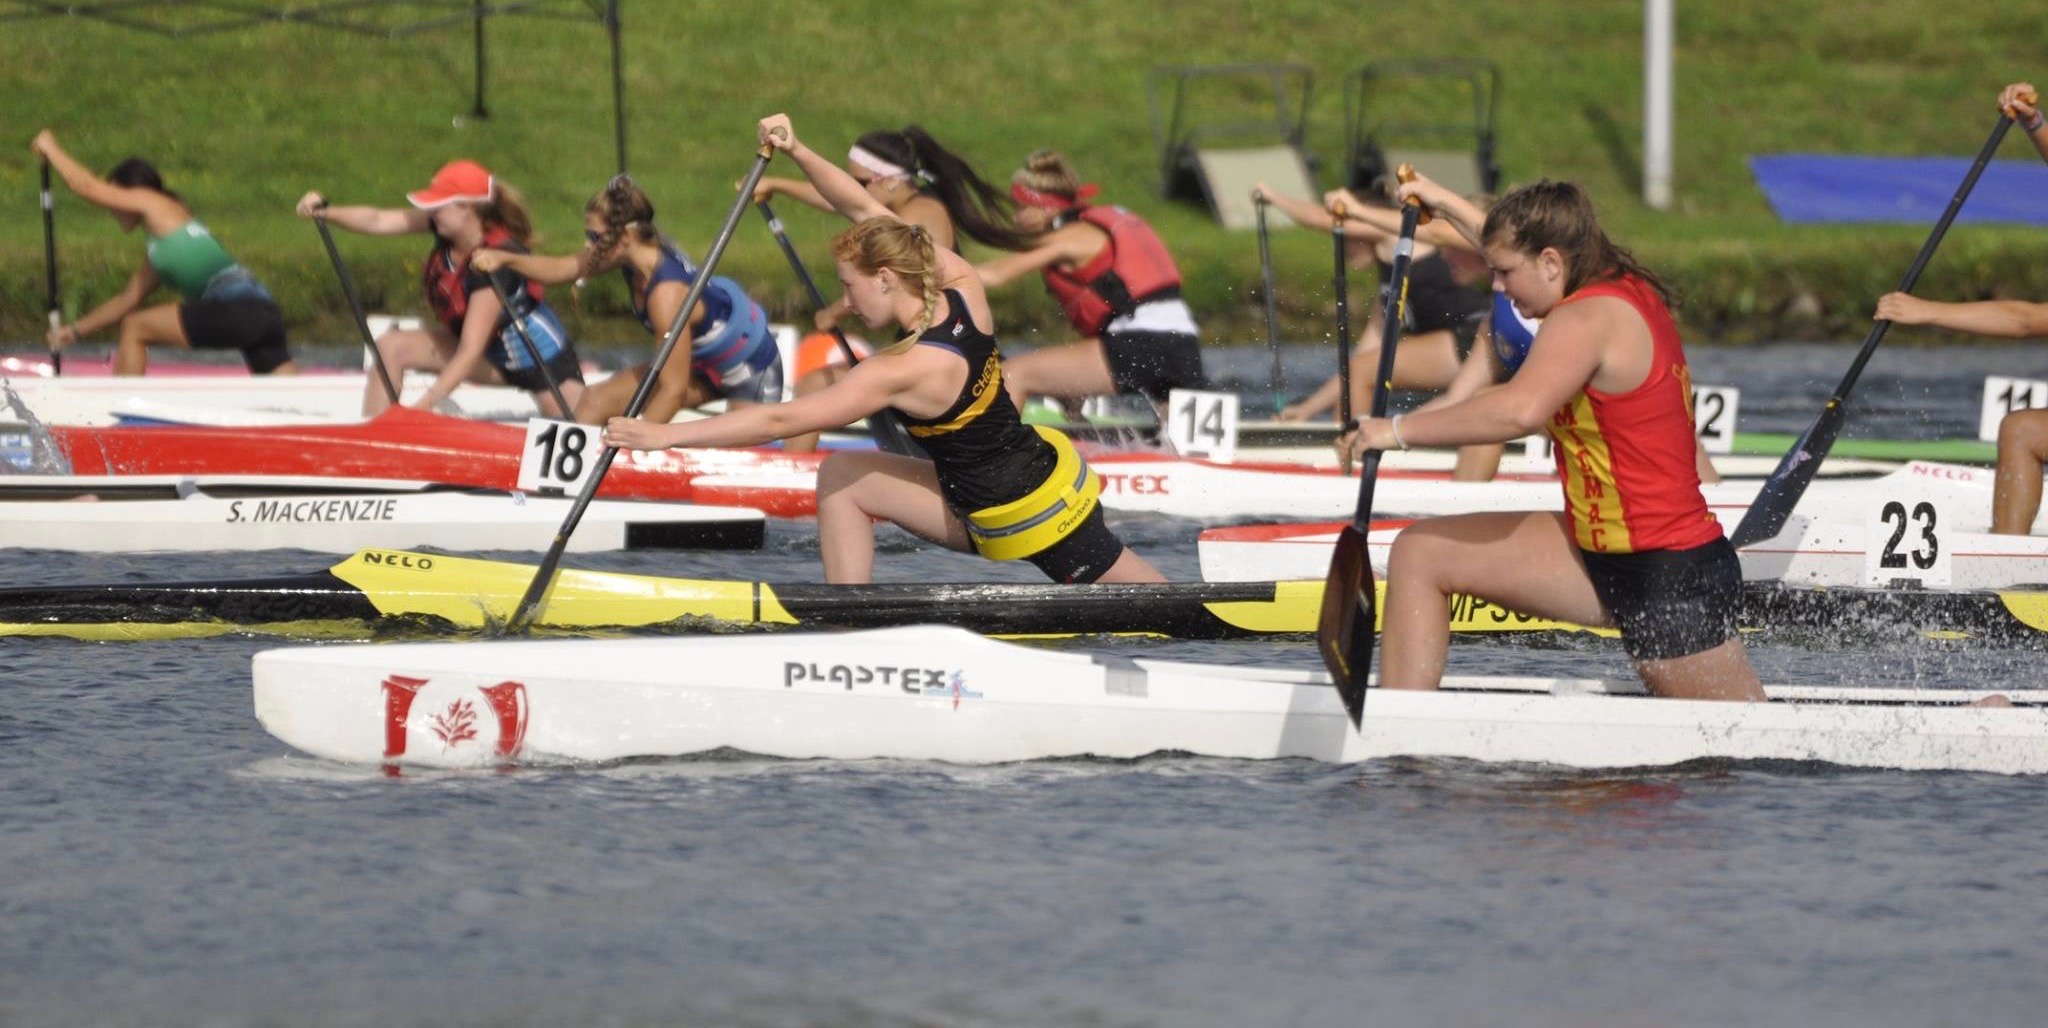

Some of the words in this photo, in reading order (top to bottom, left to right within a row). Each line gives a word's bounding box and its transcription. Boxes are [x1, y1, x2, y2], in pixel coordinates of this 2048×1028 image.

[1180, 396, 1225, 446] 14
[535, 423, 587, 483] 18
[1912, 465, 1974, 481] NELO
[226, 500, 247, 523] S.
[253, 499, 398, 522] MACKENZIE
[1880, 501, 1938, 569] 23
[363, 552, 433, 570] NELO
